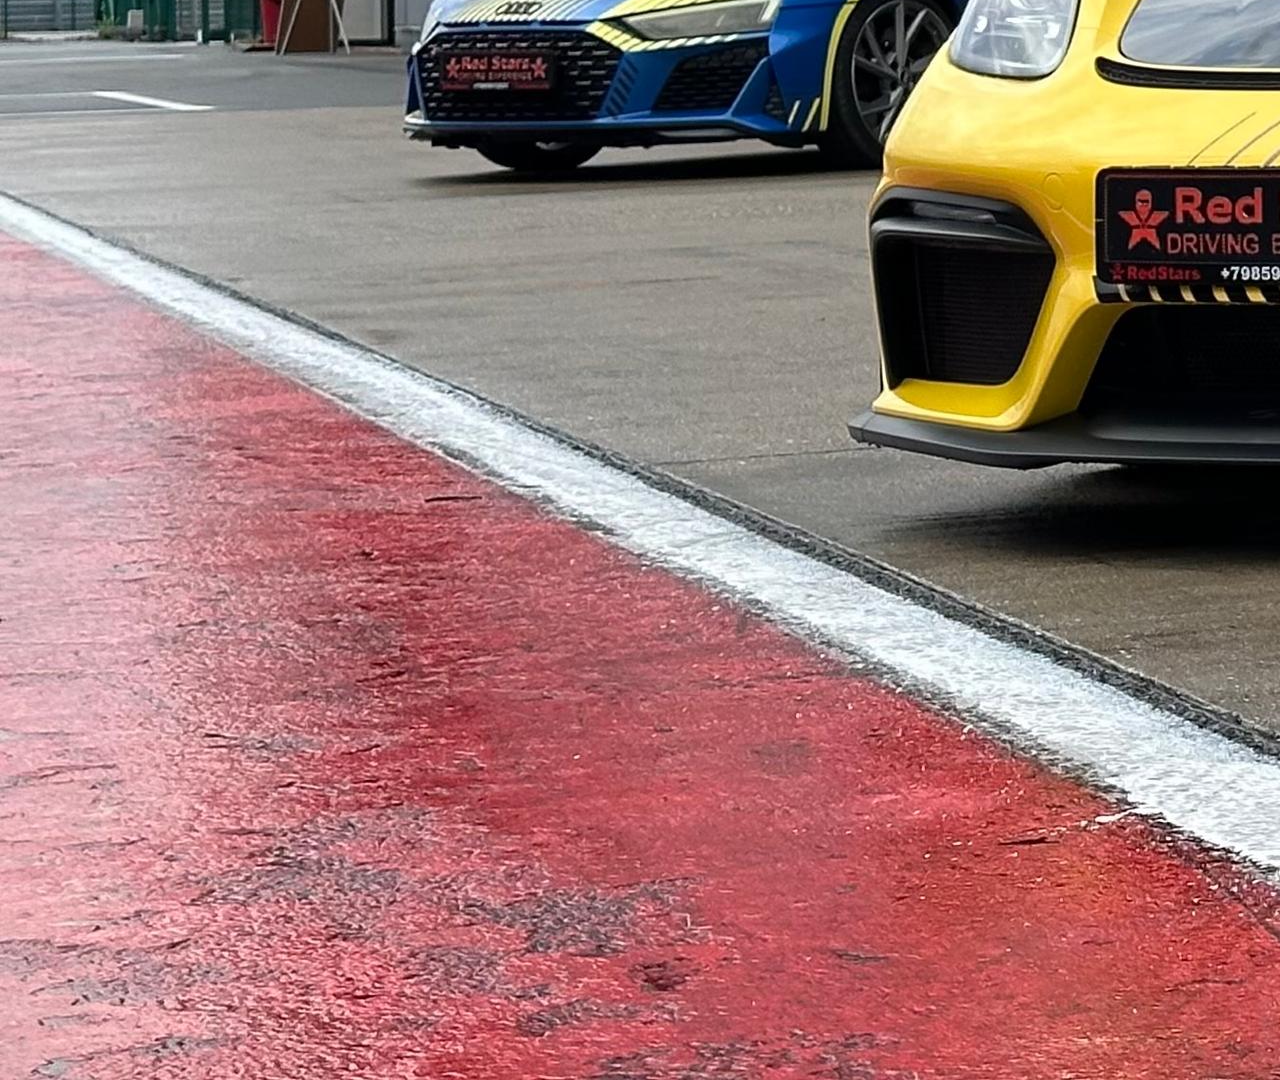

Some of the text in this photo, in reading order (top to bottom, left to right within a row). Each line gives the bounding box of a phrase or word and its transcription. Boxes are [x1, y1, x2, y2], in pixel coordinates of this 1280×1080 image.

[461, 55, 530, 70] Red Stars
[1174, 186, 1264, 224] Red
[1166, 232, 1260, 255] DRIVING
[1127, 266, 1201, 281] RedStars
